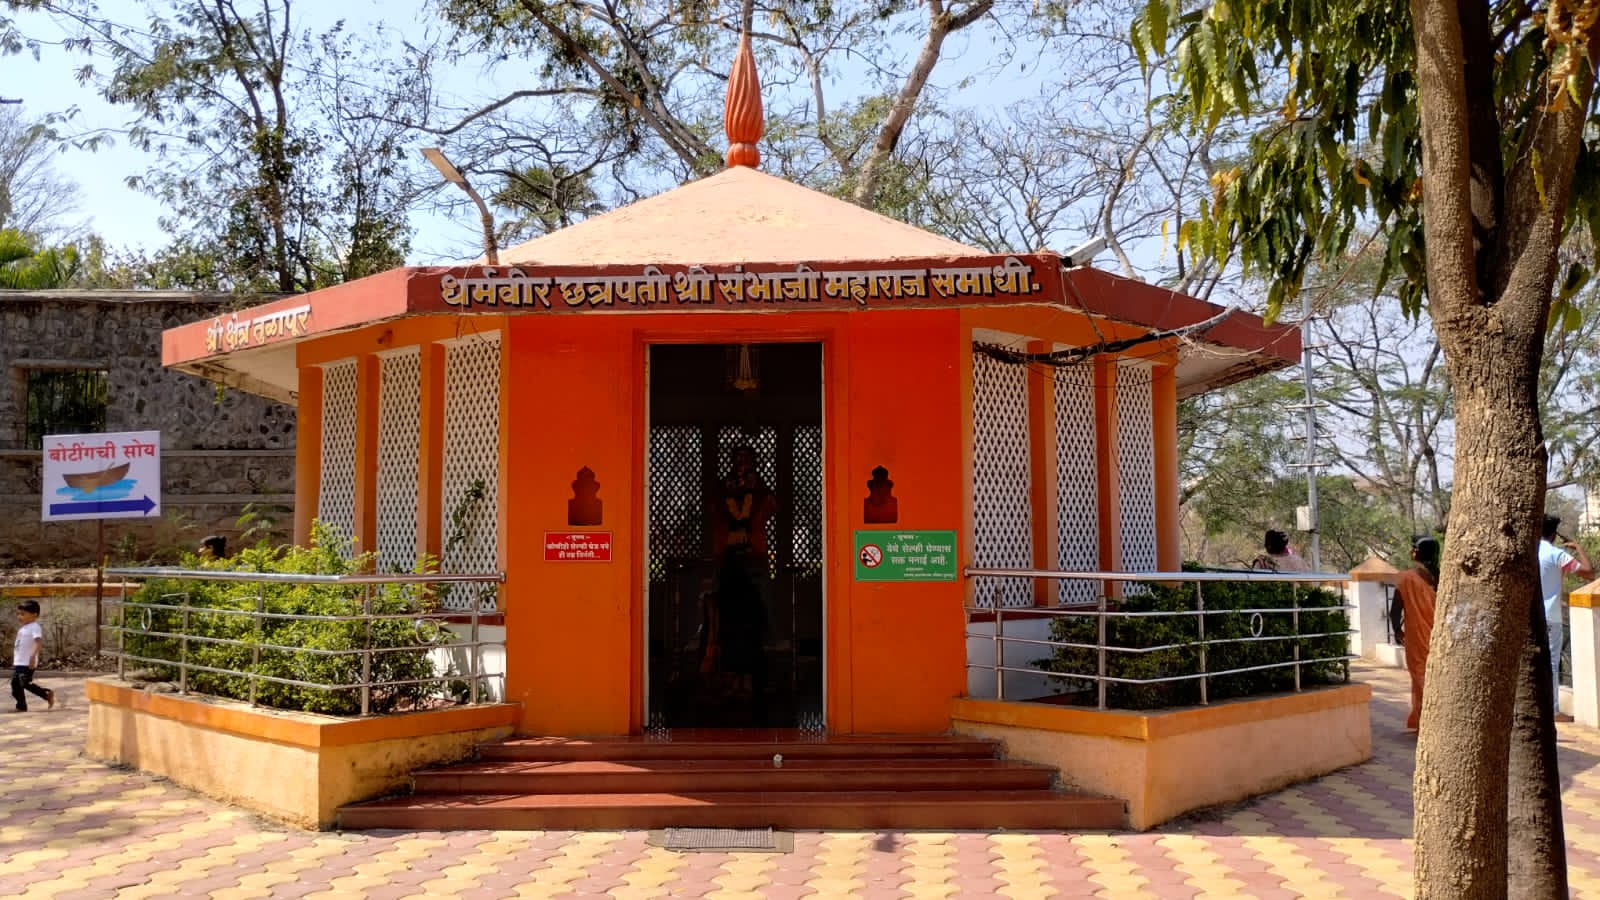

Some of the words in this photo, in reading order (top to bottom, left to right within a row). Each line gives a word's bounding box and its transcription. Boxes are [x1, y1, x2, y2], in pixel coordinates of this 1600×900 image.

[440, 267, 551, 307] धर्मवीर
[554, 266, 671, 305] छत्रपती
[673, 266, 715, 304] श्री
[718, 264, 820, 303] संभाजी
[823, 269, 930, 304] महाराज
[206, 319, 224, 352] श्री
[226, 313, 251, 350] क्षेत्र
[48, 441, 117, 462] बोटींगची
[122, 439, 156, 459] सोय
